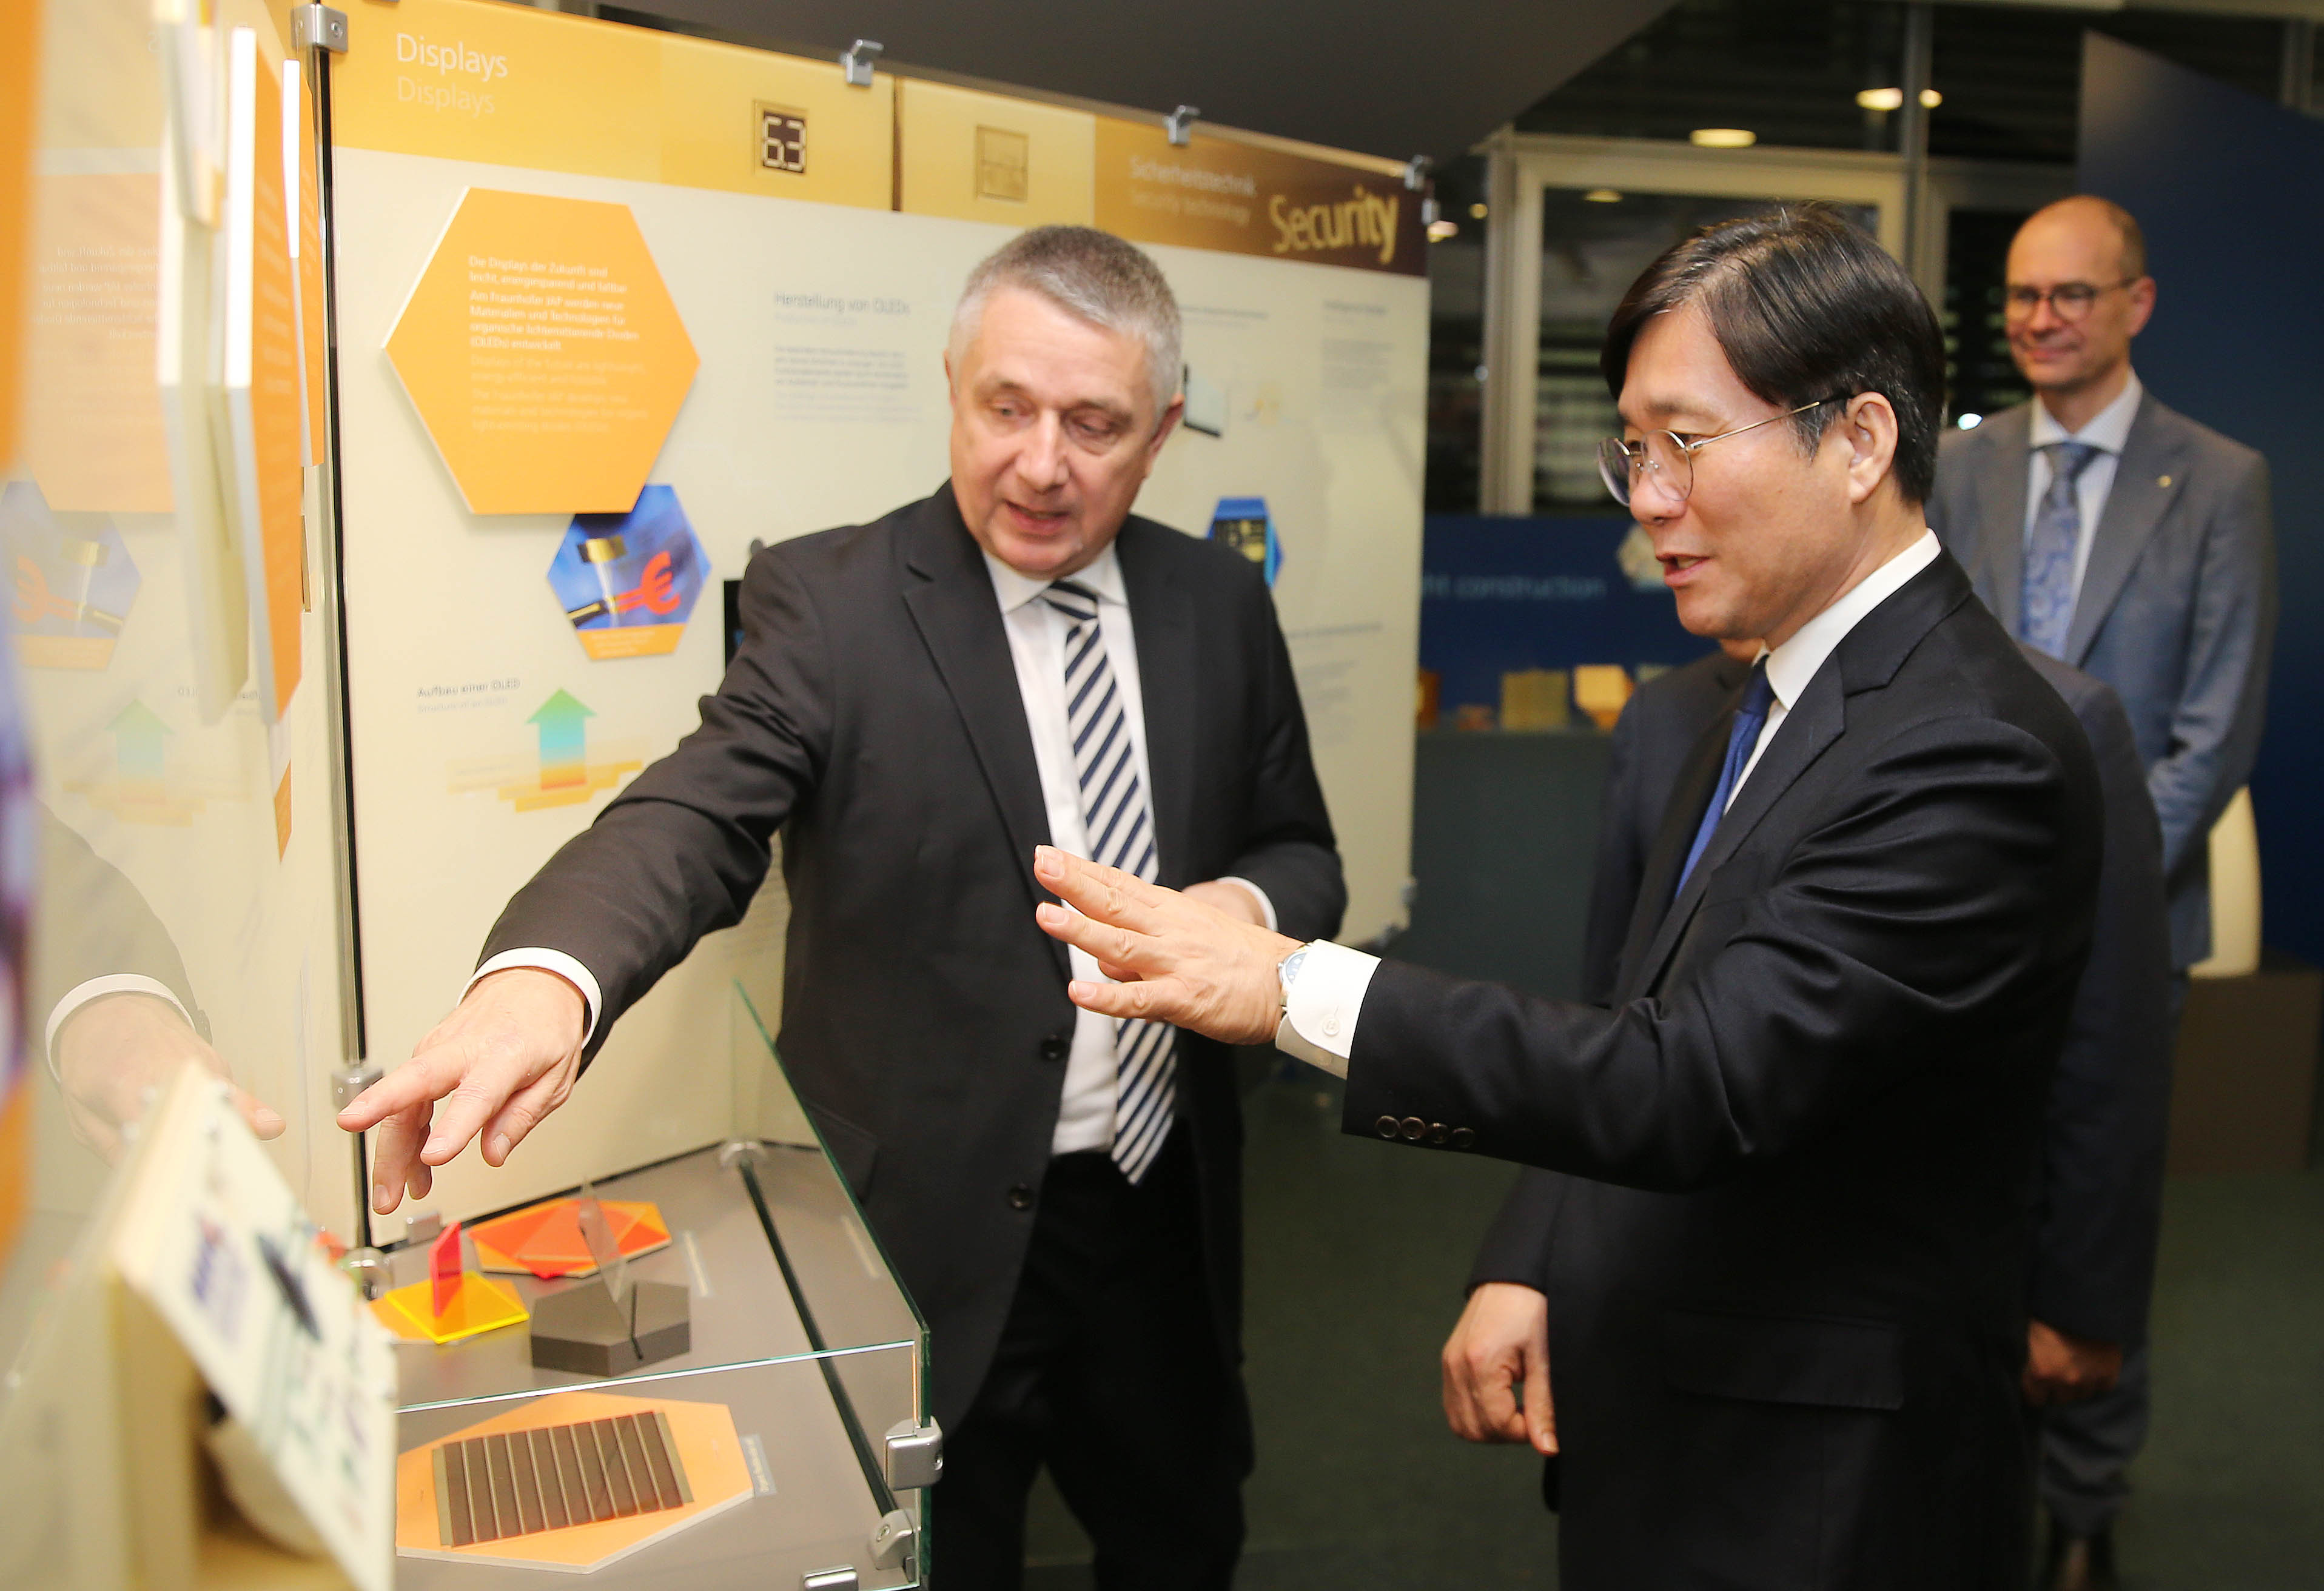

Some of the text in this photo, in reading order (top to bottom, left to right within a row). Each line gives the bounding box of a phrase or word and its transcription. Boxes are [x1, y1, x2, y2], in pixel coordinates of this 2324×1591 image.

[396, 33, 508, 82] Displays
[396, 75, 495, 119] Displays
[1269, 185, 1399, 265] Security
[488, 256, 529, 273] Displays
[548, 261, 586, 276] Zukunft
[469, 289, 488, 301] Am
[469, 305, 525, 320] Materialien
[527, 308, 547, 320] und
